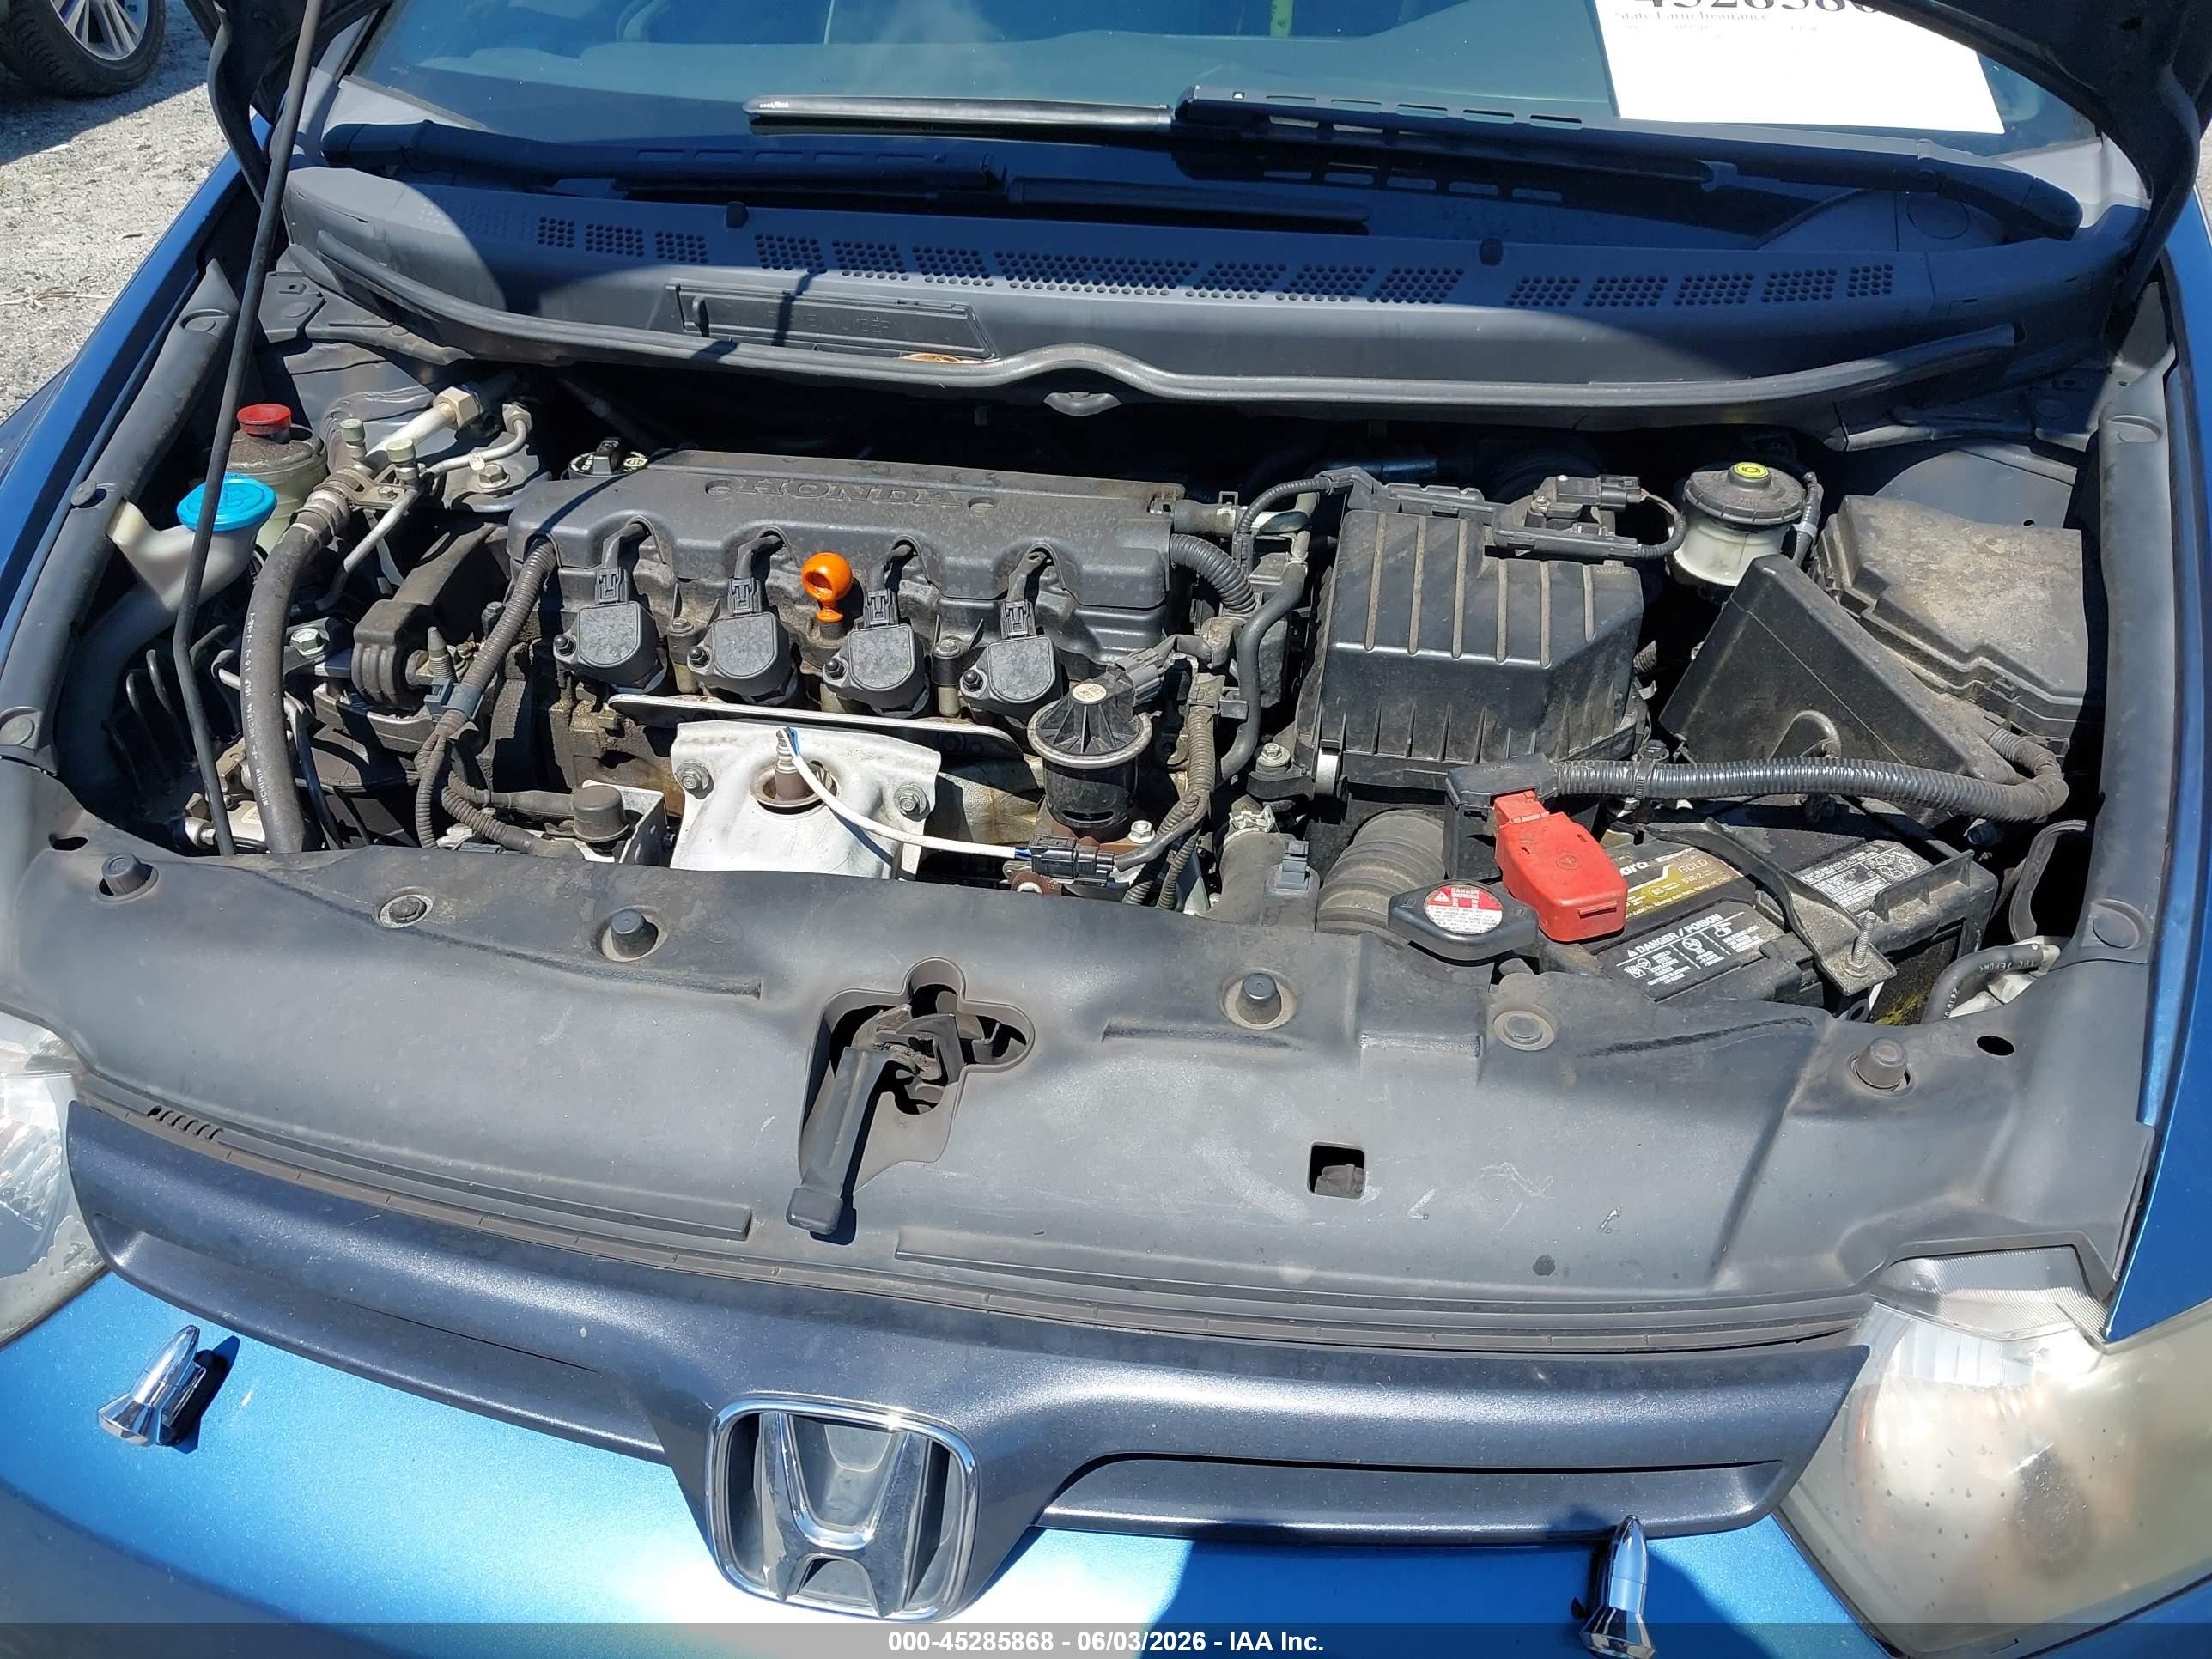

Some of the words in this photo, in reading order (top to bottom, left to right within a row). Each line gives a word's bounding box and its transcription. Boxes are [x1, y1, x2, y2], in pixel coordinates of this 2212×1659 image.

[735, 477, 963, 507] HONDA
[1678, 858, 1709, 874] GOLD
[1634, 932, 1679, 954] DANGER
[1684, 913, 1723, 933] POISON
